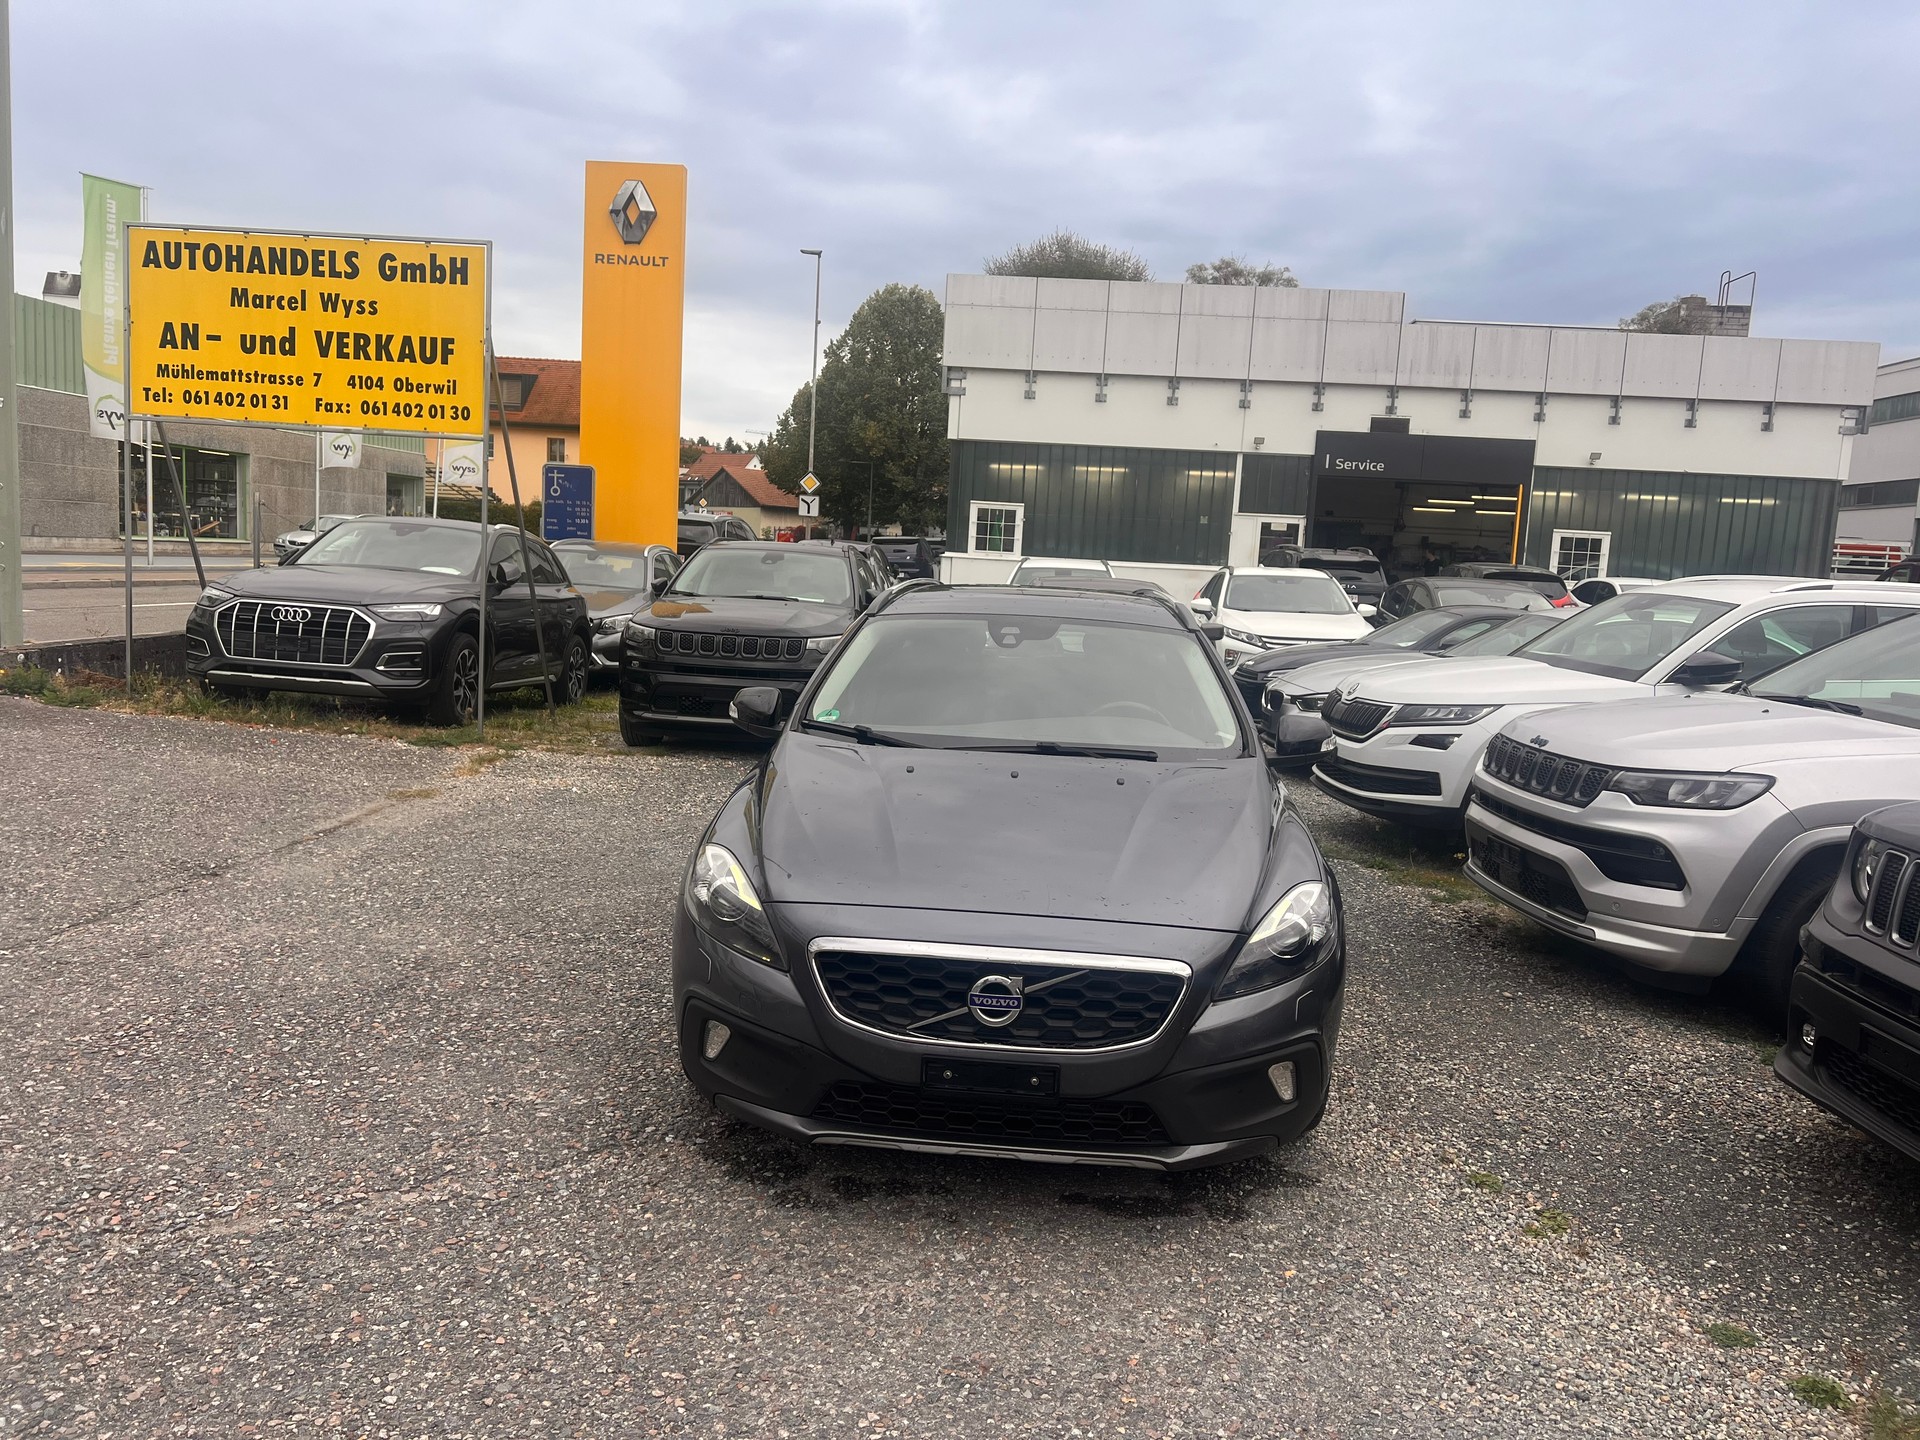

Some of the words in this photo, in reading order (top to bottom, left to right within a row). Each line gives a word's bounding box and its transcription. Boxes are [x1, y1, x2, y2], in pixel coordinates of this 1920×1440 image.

[142, 240, 360, 280] AUTOHANDELS
[378, 252, 469, 286] GmbH
[594, 253, 669, 267] RENAULT
[230, 287, 307, 311] Marcel
[319, 291, 379, 319] Wyss
[239, 326, 296, 357] und
[313, 330, 455, 365] VERKAUF
[156, 363, 305, 387] Mühlemattstrasse
[313, 372, 323, 387] 7
[346, 374, 385, 391] 4104
[393, 376, 457, 395] Oberwil
[142, 387, 173, 404] Tel:
[315, 397, 351, 415] Fax:
[451, 464, 476, 479] wyss
[1335, 458, 1385, 472] Service
[972, 996, 1018, 1007] VOLVO
